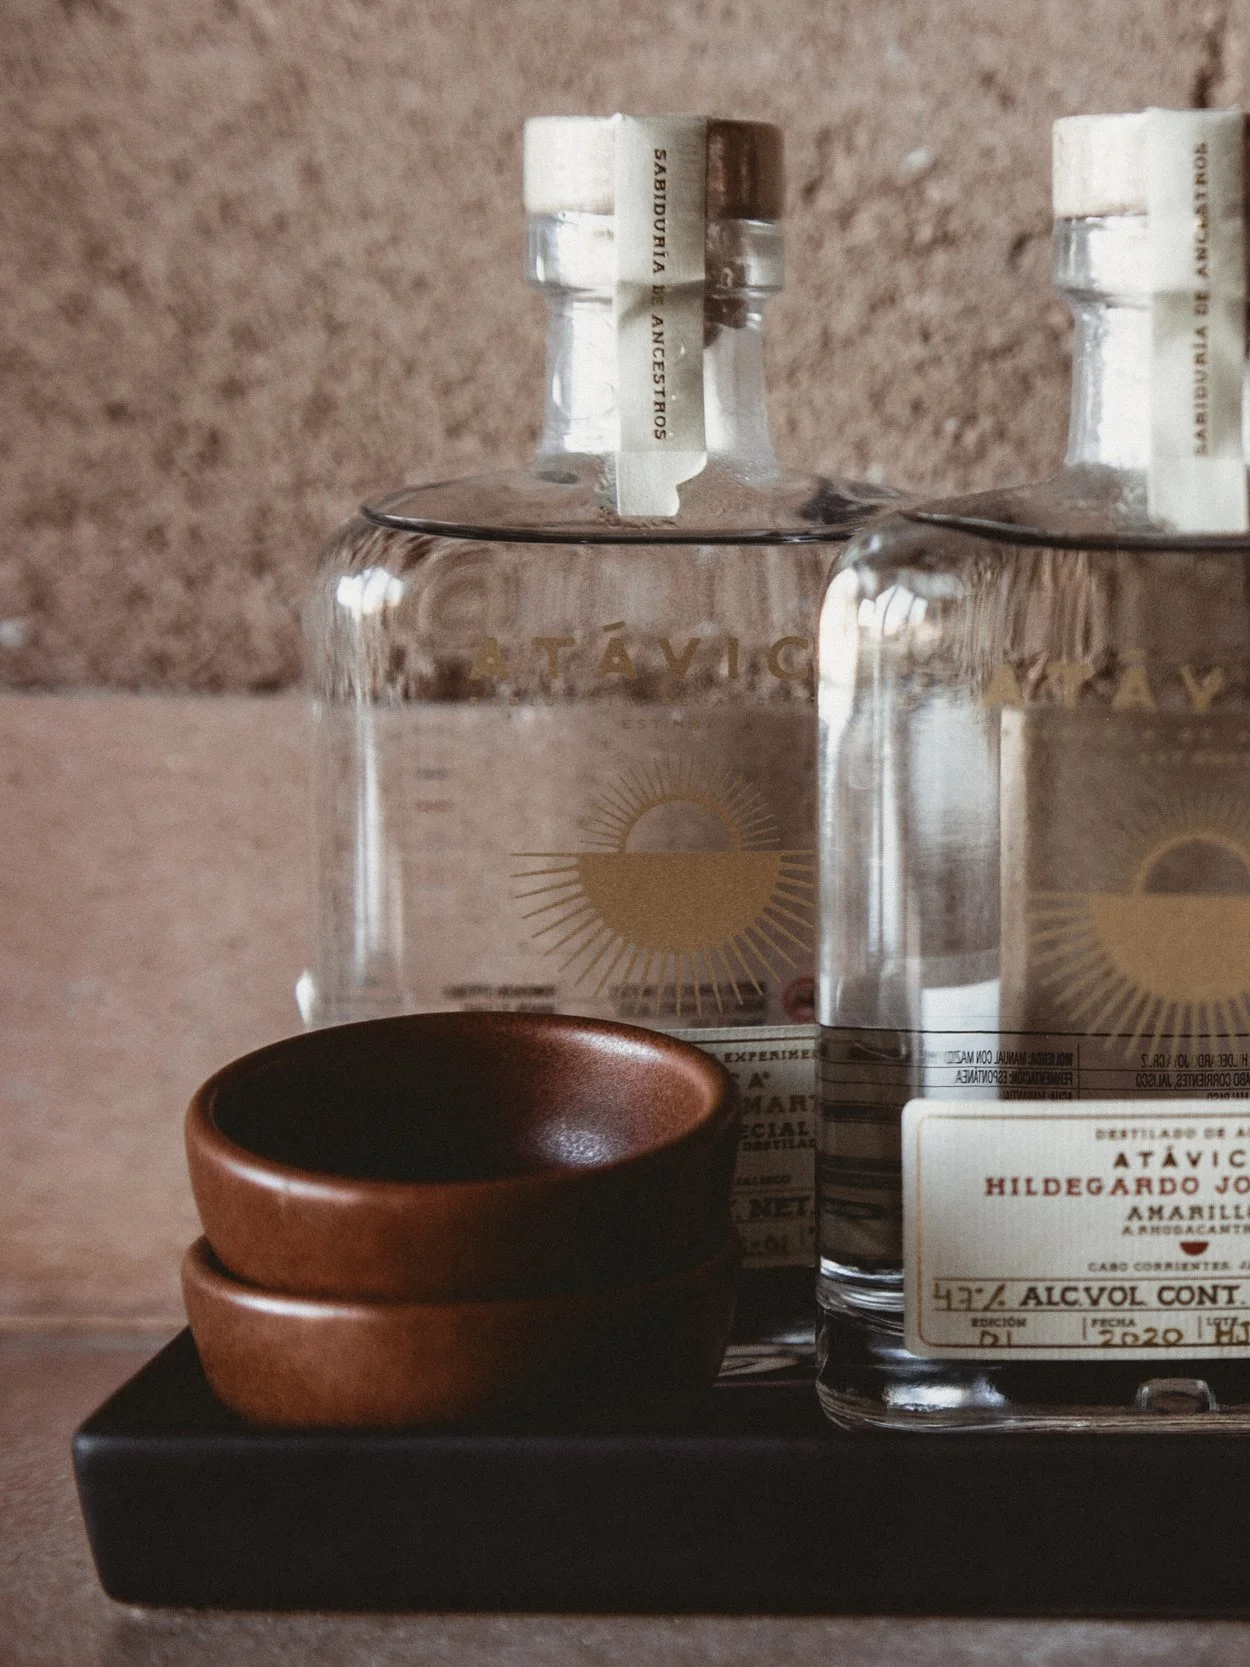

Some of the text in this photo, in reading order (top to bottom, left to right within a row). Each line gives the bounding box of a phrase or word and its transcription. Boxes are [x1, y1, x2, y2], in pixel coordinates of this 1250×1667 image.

[653, 283, 666, 311] DE
[651, 314, 667, 441] ANCESTROS
[469, 621, 809, 682] ATÁVIC
[1204, 1128, 1226, 1140] DE
[985, 1176, 1200, 1196] HILDEGARDO
[970, 1316, 1027, 1329] EDICIÓN
[1091, 1317, 1136, 1328] FECHA
[1098, 1327, 1184, 1346] 2020
